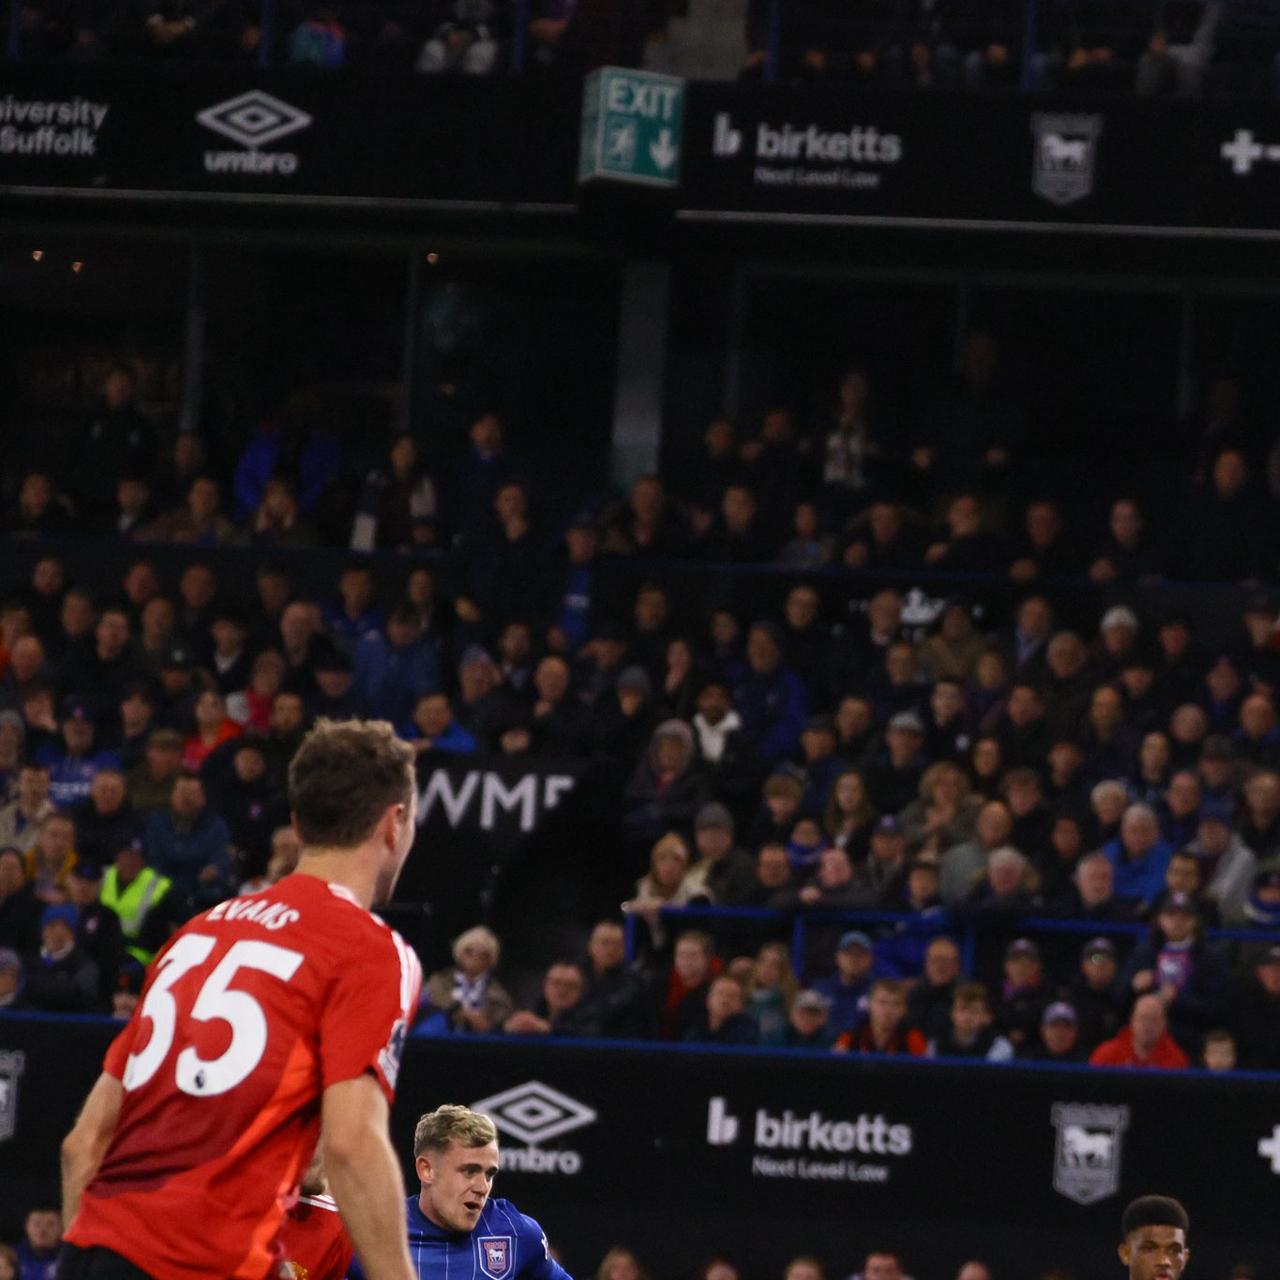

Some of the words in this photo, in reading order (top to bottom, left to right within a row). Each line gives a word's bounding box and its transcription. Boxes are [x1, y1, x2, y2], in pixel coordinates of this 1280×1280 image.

[0, 95, 108, 131] iversity
[607, 77, 678, 119] EXIT
[757, 122, 901, 163] birketts
[204, 151, 298, 175] umbro
[205, 898, 300, 931] EVANS
[122, 932, 305, 1097] 35
[753, 1107, 912, 1155] birketts
[499, 1147, 583, 1175] mbro
[751, 1154, 795, 1177] Next
[798, 1157, 846, 1180] Level
